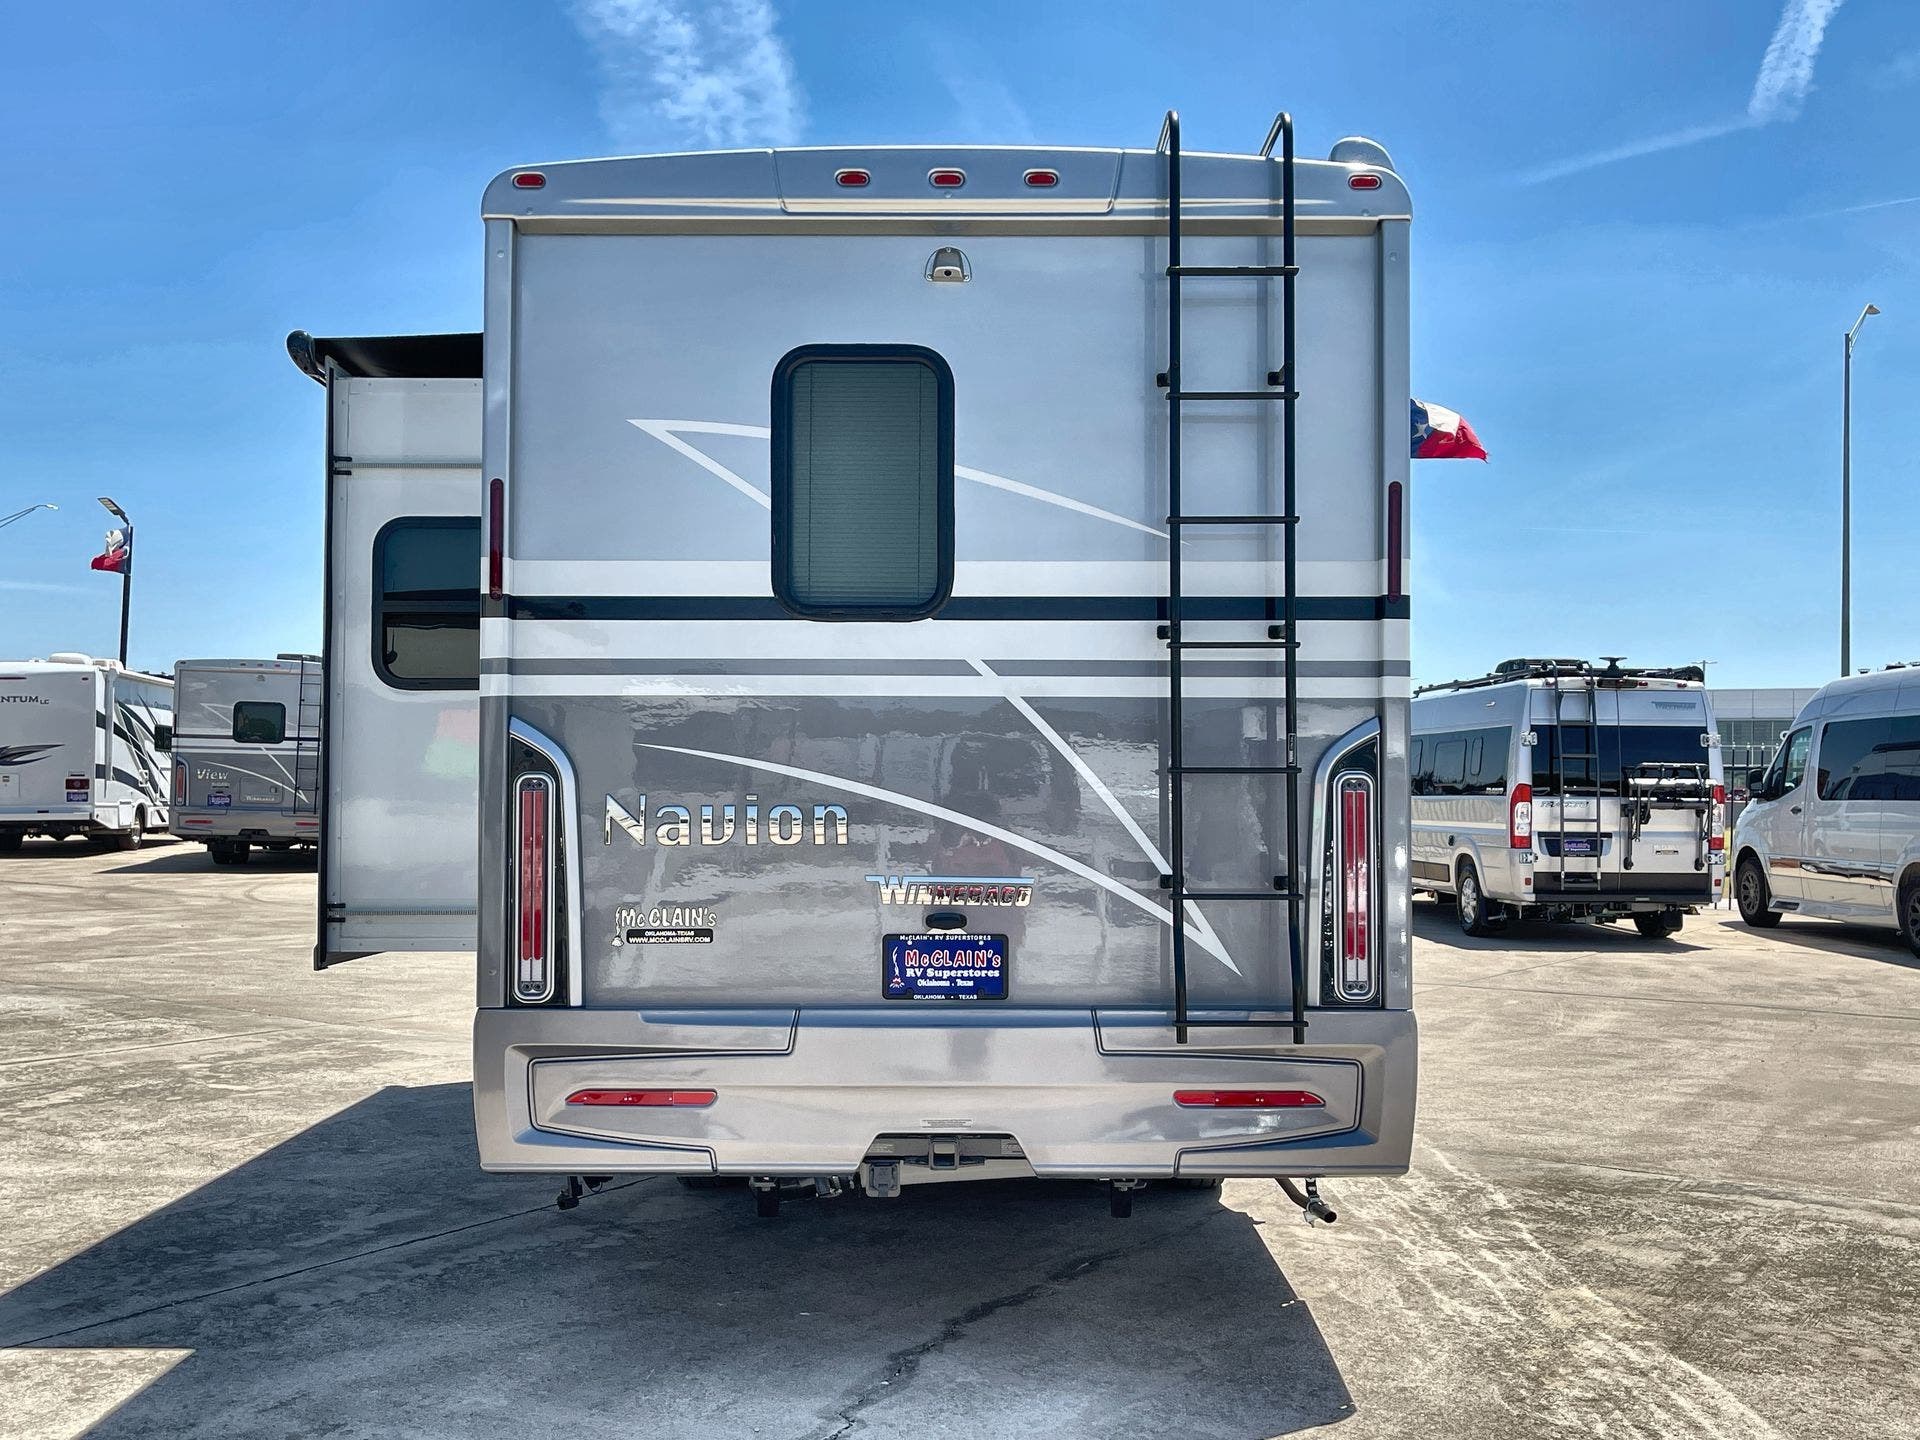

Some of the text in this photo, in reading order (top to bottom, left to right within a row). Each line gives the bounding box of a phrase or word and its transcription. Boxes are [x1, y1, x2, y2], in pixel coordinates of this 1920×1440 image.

[196, 768, 229, 780] View
[604, 793, 849, 846] Navion
[904, 949, 1001, 968] McCLAIN's
[905, 968, 1000, 979] RV Superstores
[916, 979, 974, 987] Oklahoma Texas
